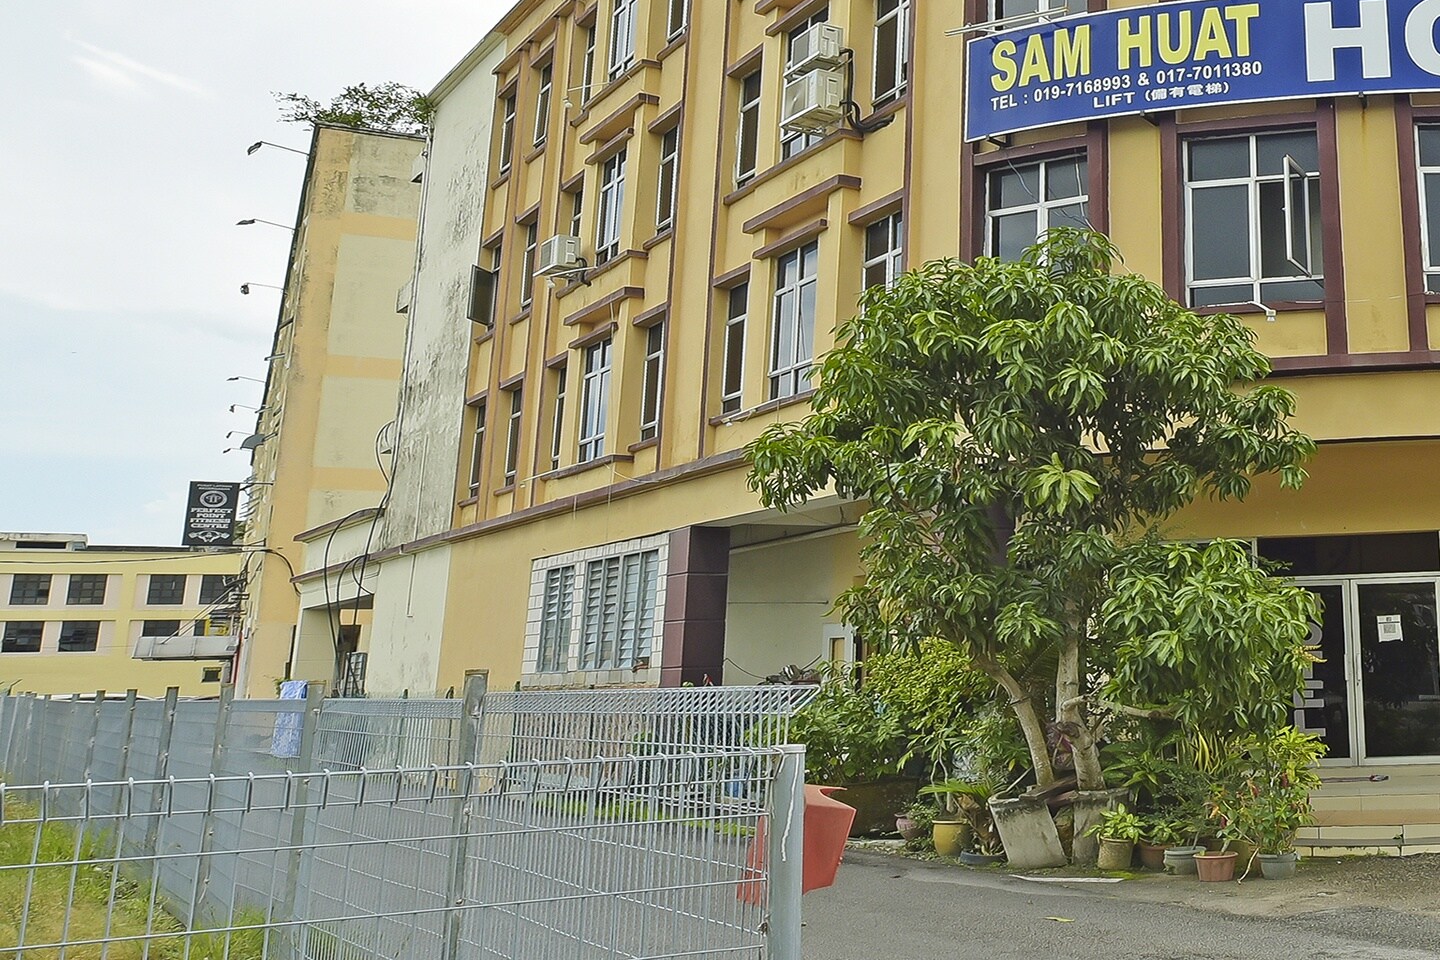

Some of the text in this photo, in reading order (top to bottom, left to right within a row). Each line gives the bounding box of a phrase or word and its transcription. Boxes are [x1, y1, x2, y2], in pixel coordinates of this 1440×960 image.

[990, 3, 1260, 92] SAM HUAT
[990, 94, 1018, 111] TEL
[1034, 75, 1131, 103] 019-7168993
[1137, 73, 1150, 87] &
[1156, 60, 1262, 84] 017-7011380
[1093, 91, 1136, 109] LIFT
